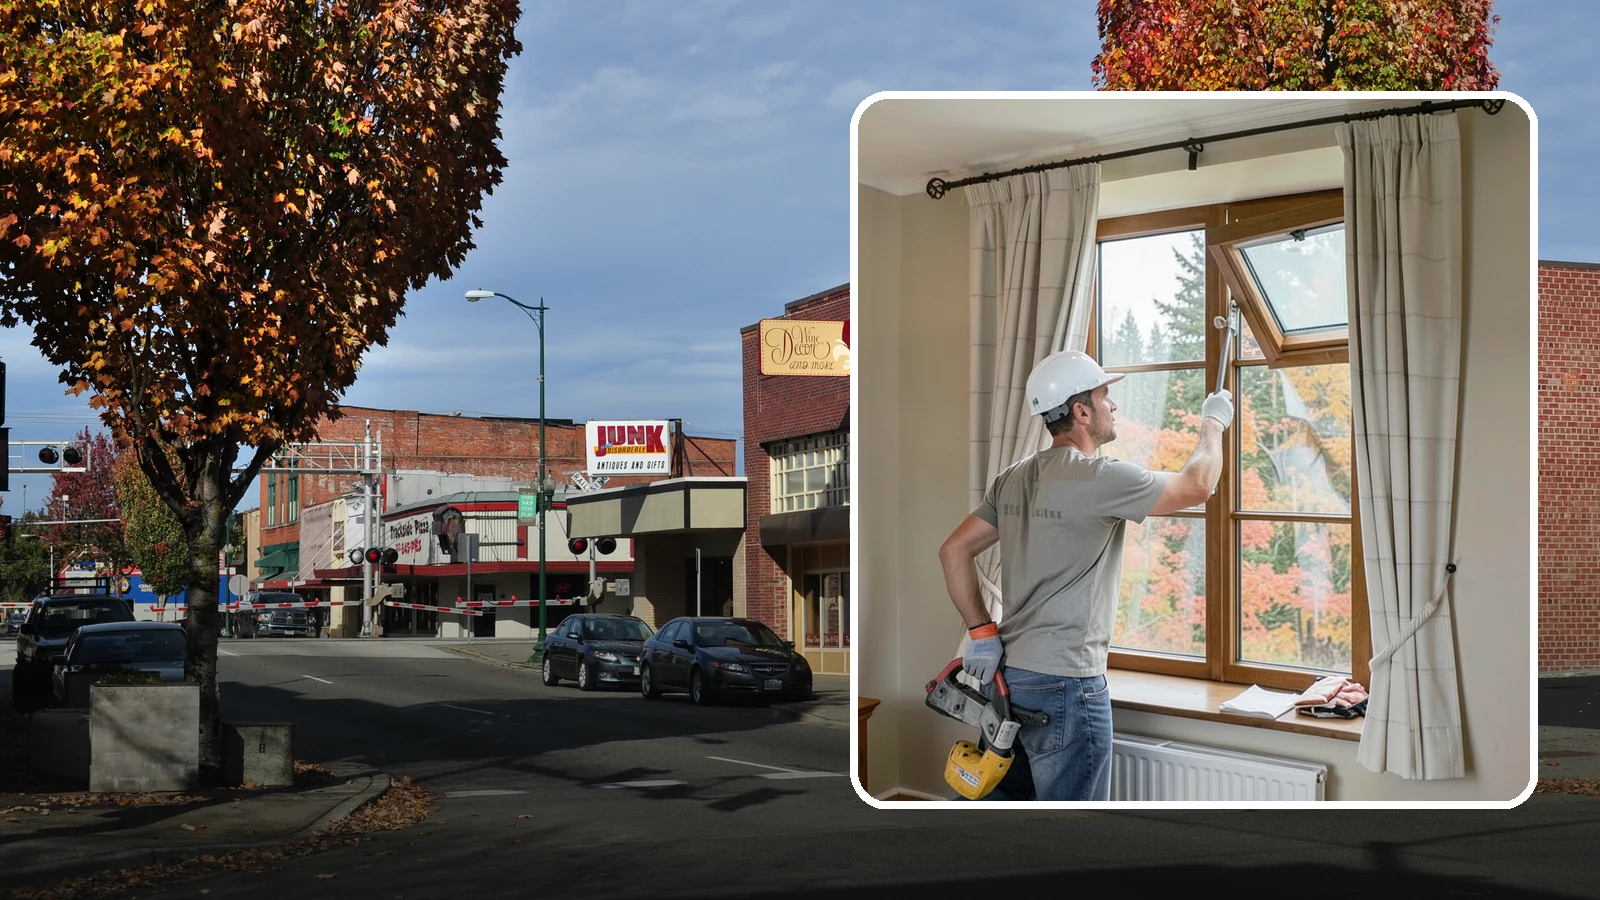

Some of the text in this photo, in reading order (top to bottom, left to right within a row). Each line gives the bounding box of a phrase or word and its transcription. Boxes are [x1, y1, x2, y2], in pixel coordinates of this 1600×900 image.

[595, 425, 665, 457] JUNK
[607, 446, 646, 454] DISORDERLY
[597, 460, 665, 470] ANTIQUES AND GIFTS
[352, 498, 365, 511] CRO
[415, 519, 430, 536] Pizza
